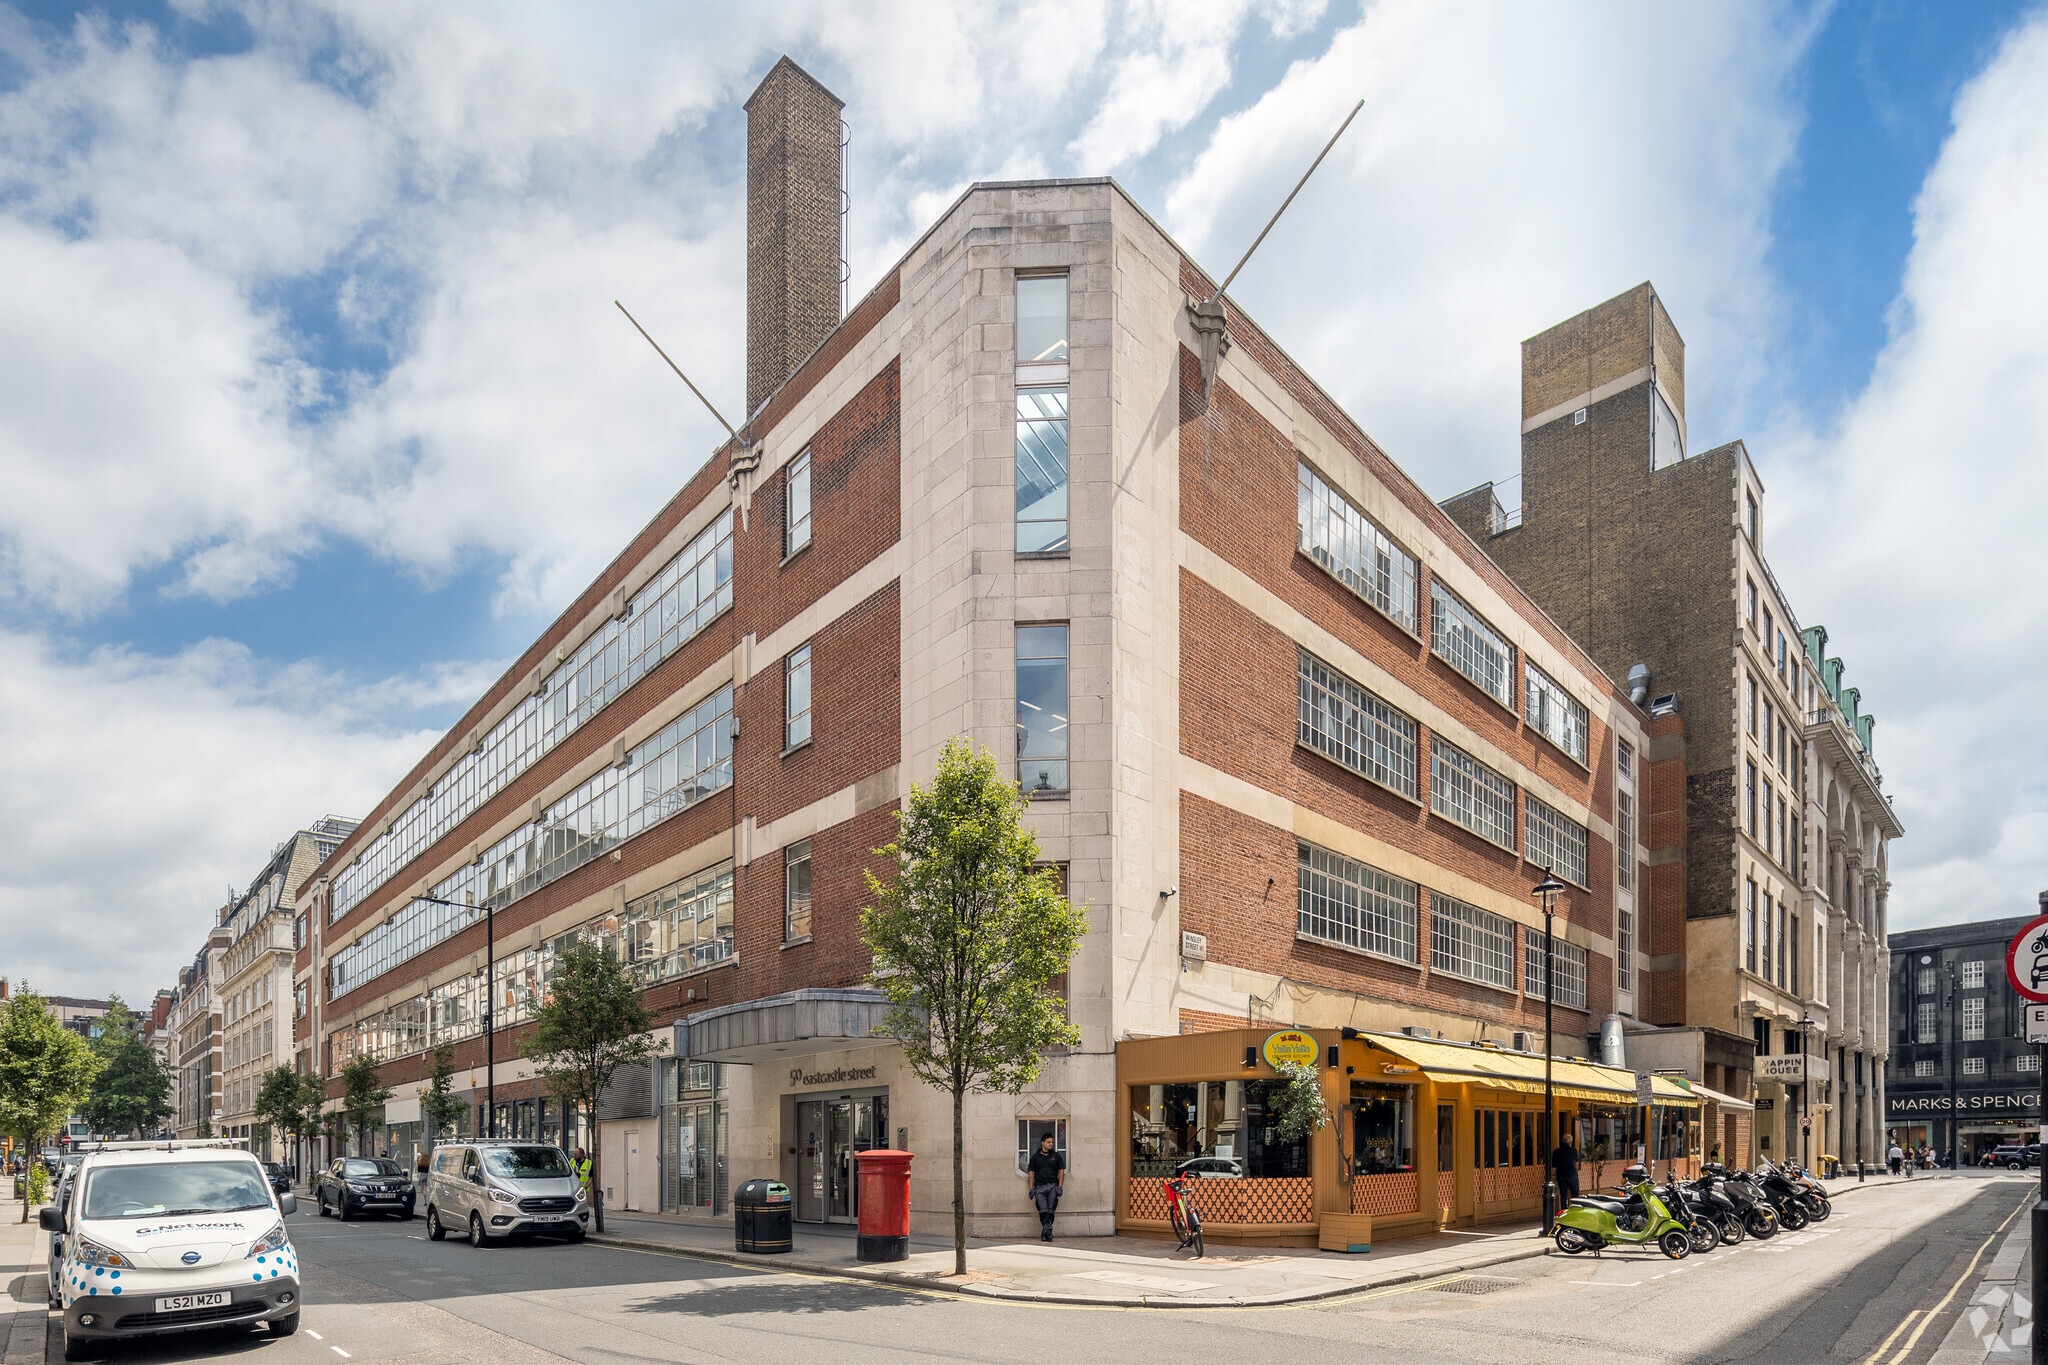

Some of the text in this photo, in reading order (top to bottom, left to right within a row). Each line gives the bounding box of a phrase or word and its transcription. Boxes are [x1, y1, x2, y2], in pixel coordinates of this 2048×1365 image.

[1185, 942, 1199, 951] STREET
[789, 1065, 876, 1087] 50 eastcastle street
[1892, 1094, 2041, 1110] MARKS & SPENCE
[164, 1294, 222, 1309] LS21 MZO
